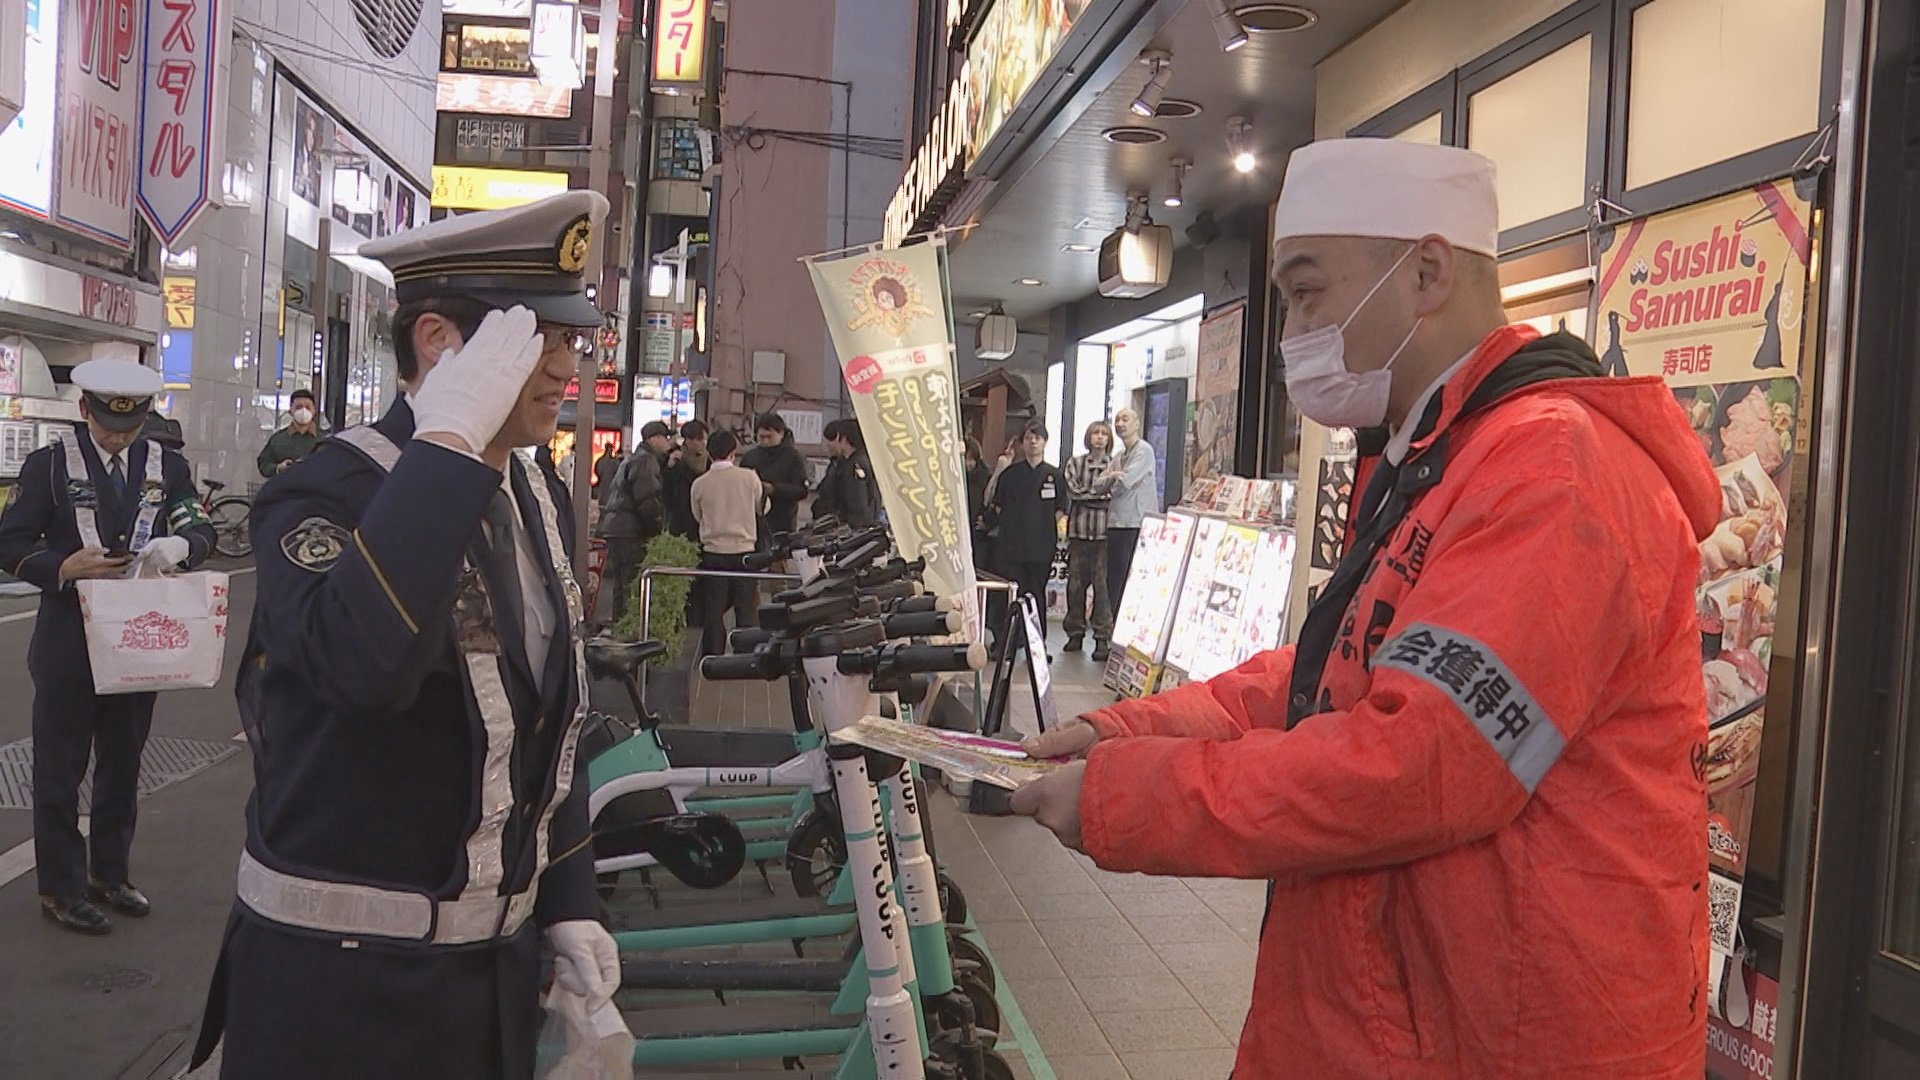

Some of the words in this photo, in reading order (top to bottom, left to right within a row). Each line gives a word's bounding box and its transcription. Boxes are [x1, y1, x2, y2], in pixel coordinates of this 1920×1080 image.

[76, 0, 136, 91] VIP
[150, 0, 196, 178] スタル
[1650, 218, 1744, 287] Sushi
[1625, 260, 1767, 333] Samurai
[1662, 344, 1713, 376] 寿司店
[1388, 628, 1531, 742] 会獲得中
[719, 772, 758, 784] LUUP
[872, 863, 894, 940] LUUP
